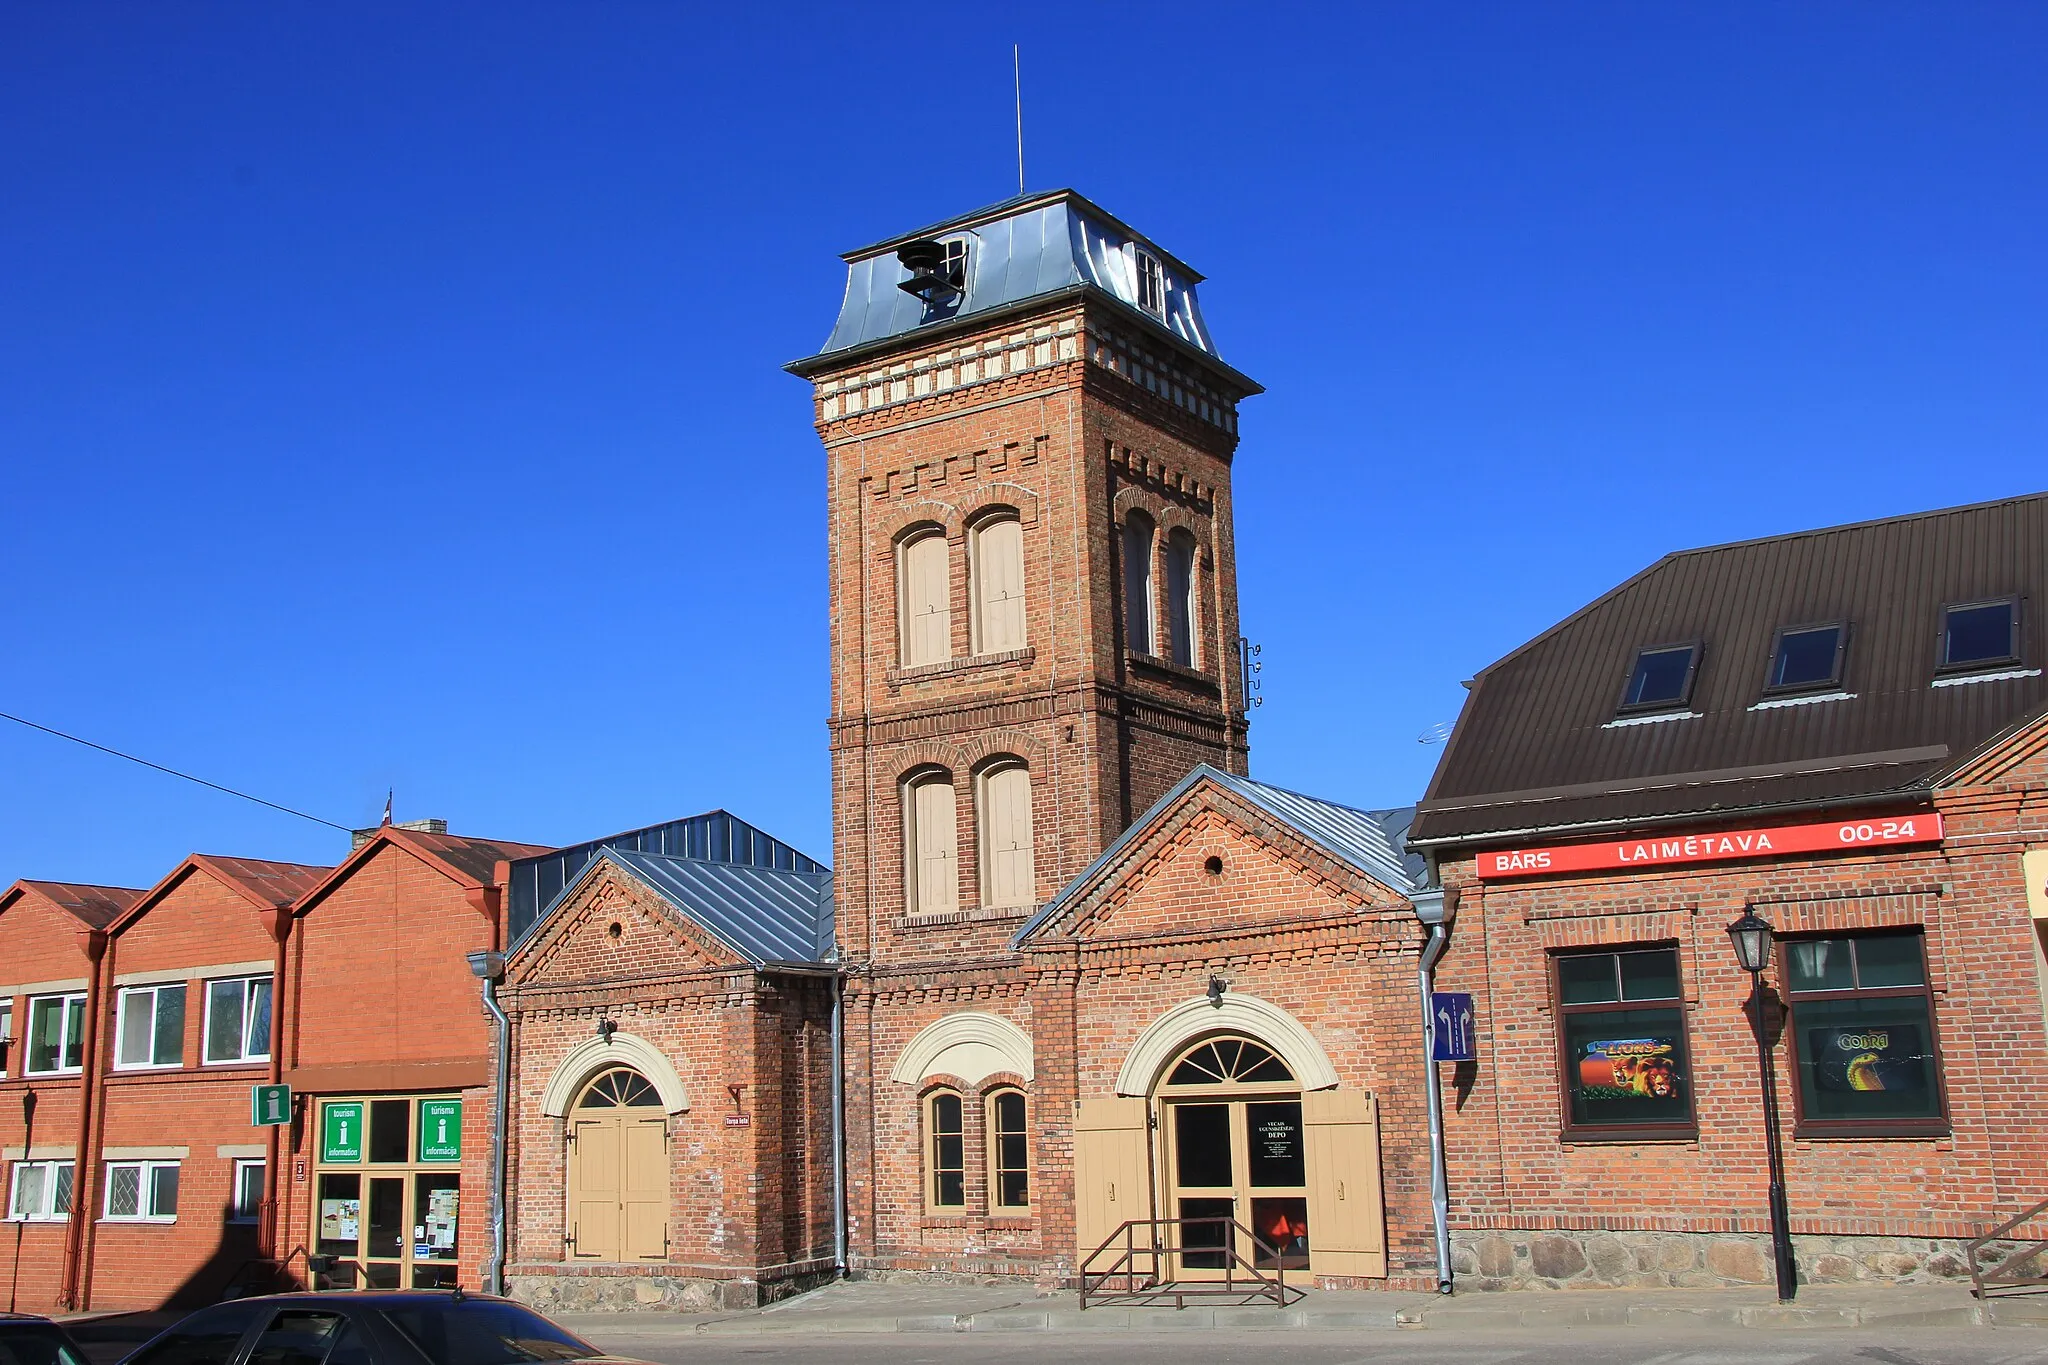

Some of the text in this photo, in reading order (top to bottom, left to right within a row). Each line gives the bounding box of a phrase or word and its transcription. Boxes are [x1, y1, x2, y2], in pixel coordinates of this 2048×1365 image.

[1495, 820, 1916, 871] BĀRS LAIMĒTAVA 00-24
[1607, 1042, 1655, 1054] LIONS
[1838, 1033, 1889, 1051] COBRA
[333, 1108, 355, 1117] tourism
[328, 1147, 358, 1157] information
